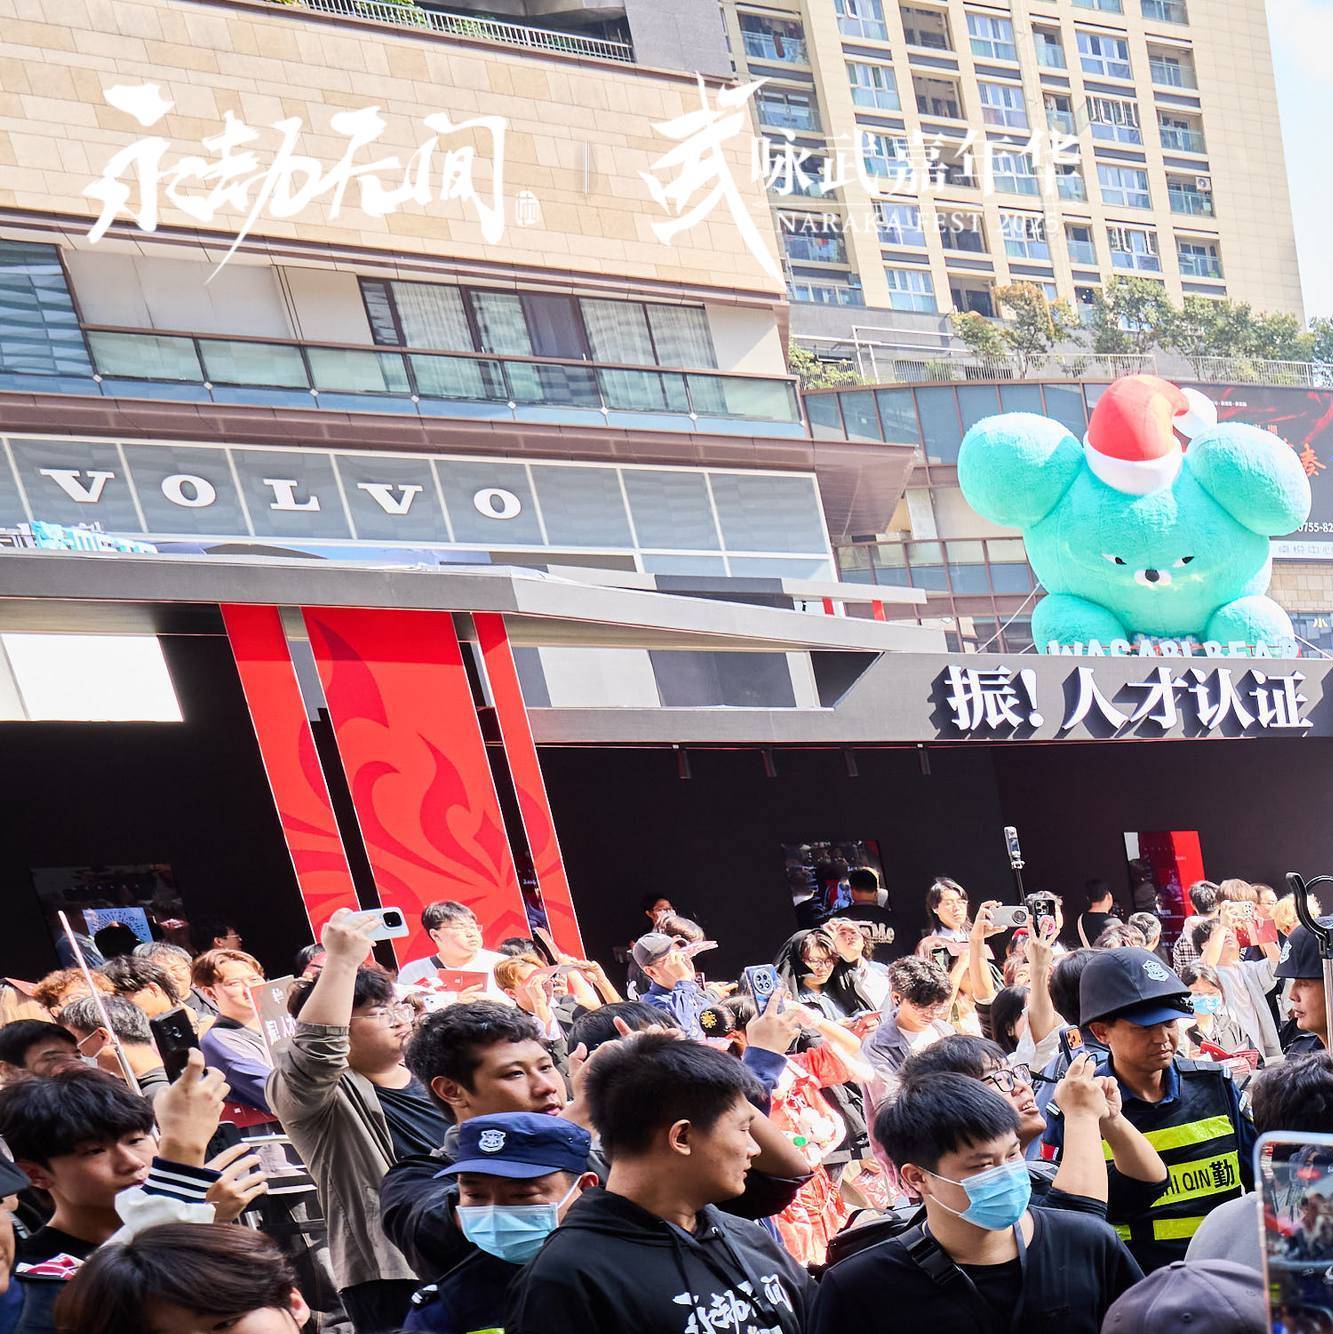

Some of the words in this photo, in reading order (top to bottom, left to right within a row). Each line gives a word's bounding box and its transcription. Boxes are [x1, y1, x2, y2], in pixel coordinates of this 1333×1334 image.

[40, 466, 523, 521] VOLVO
[1182, 1168, 1211, 1191] QIN
[1209, 1158, 1235, 1189] 勤
